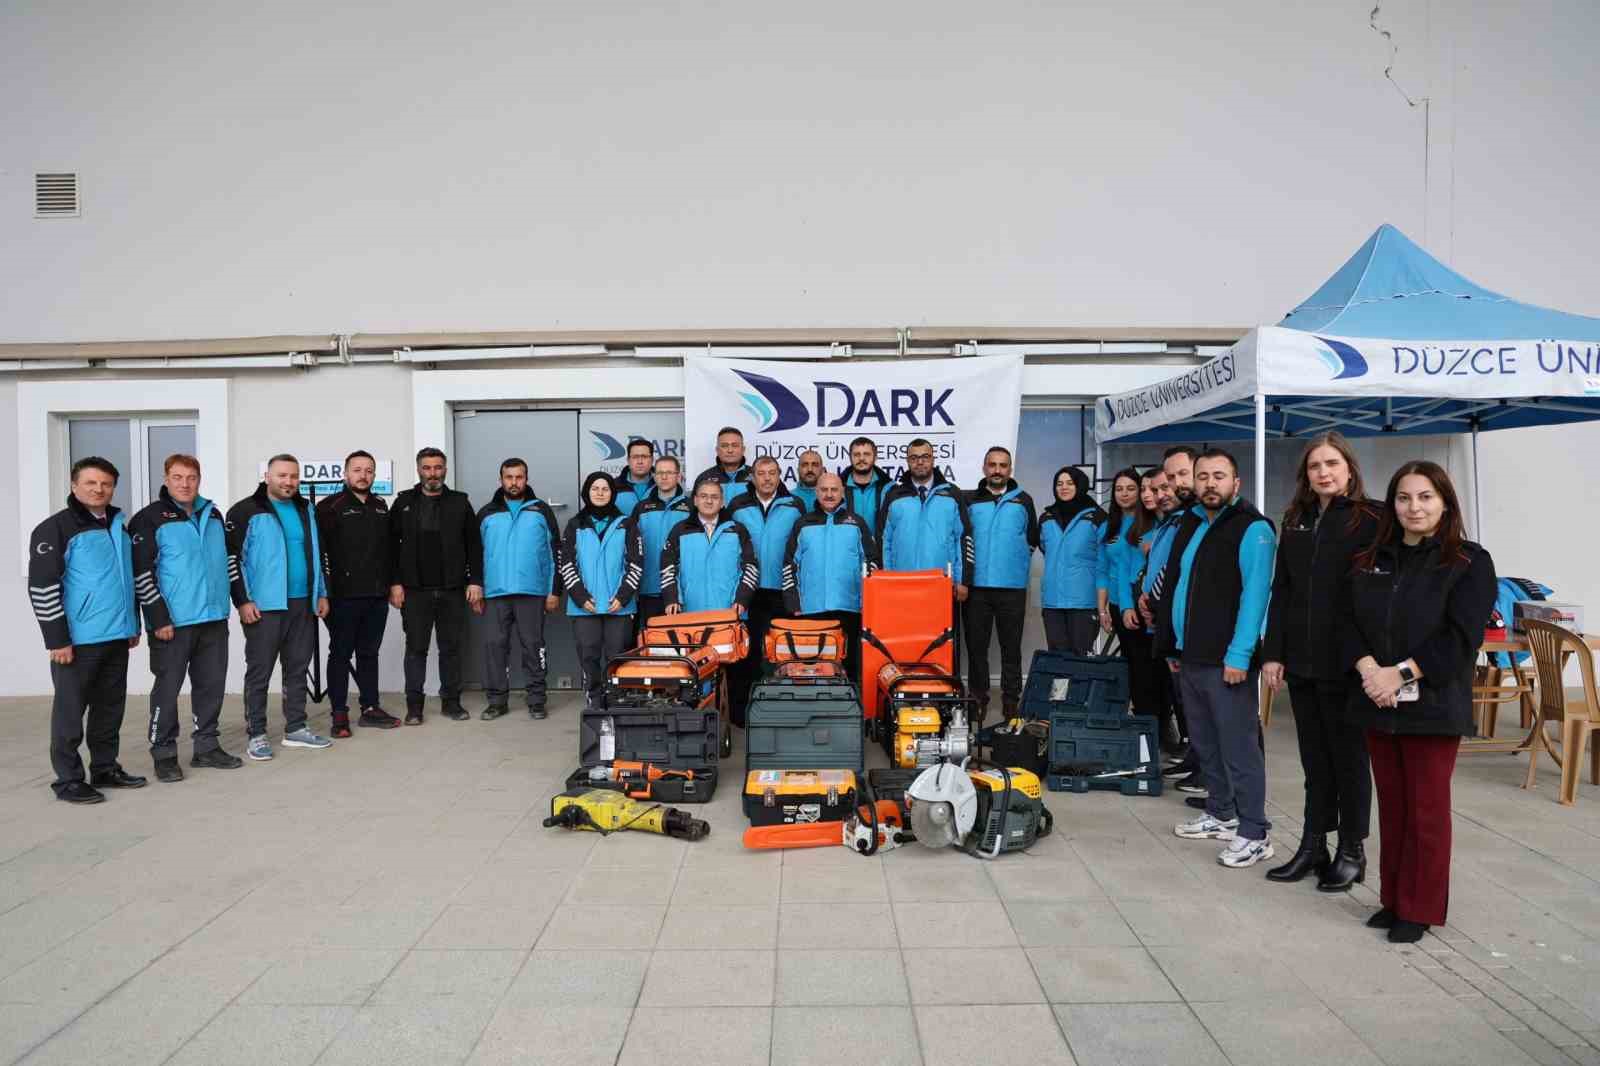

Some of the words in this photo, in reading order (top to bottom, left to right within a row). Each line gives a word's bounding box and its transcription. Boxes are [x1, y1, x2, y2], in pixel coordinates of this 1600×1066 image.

[1392, 346, 1517, 376] DÜZCE
[812, 381, 956, 427] DARK
[755, 441, 820, 460] DÜZC
[304, 464, 345, 478] DAR
